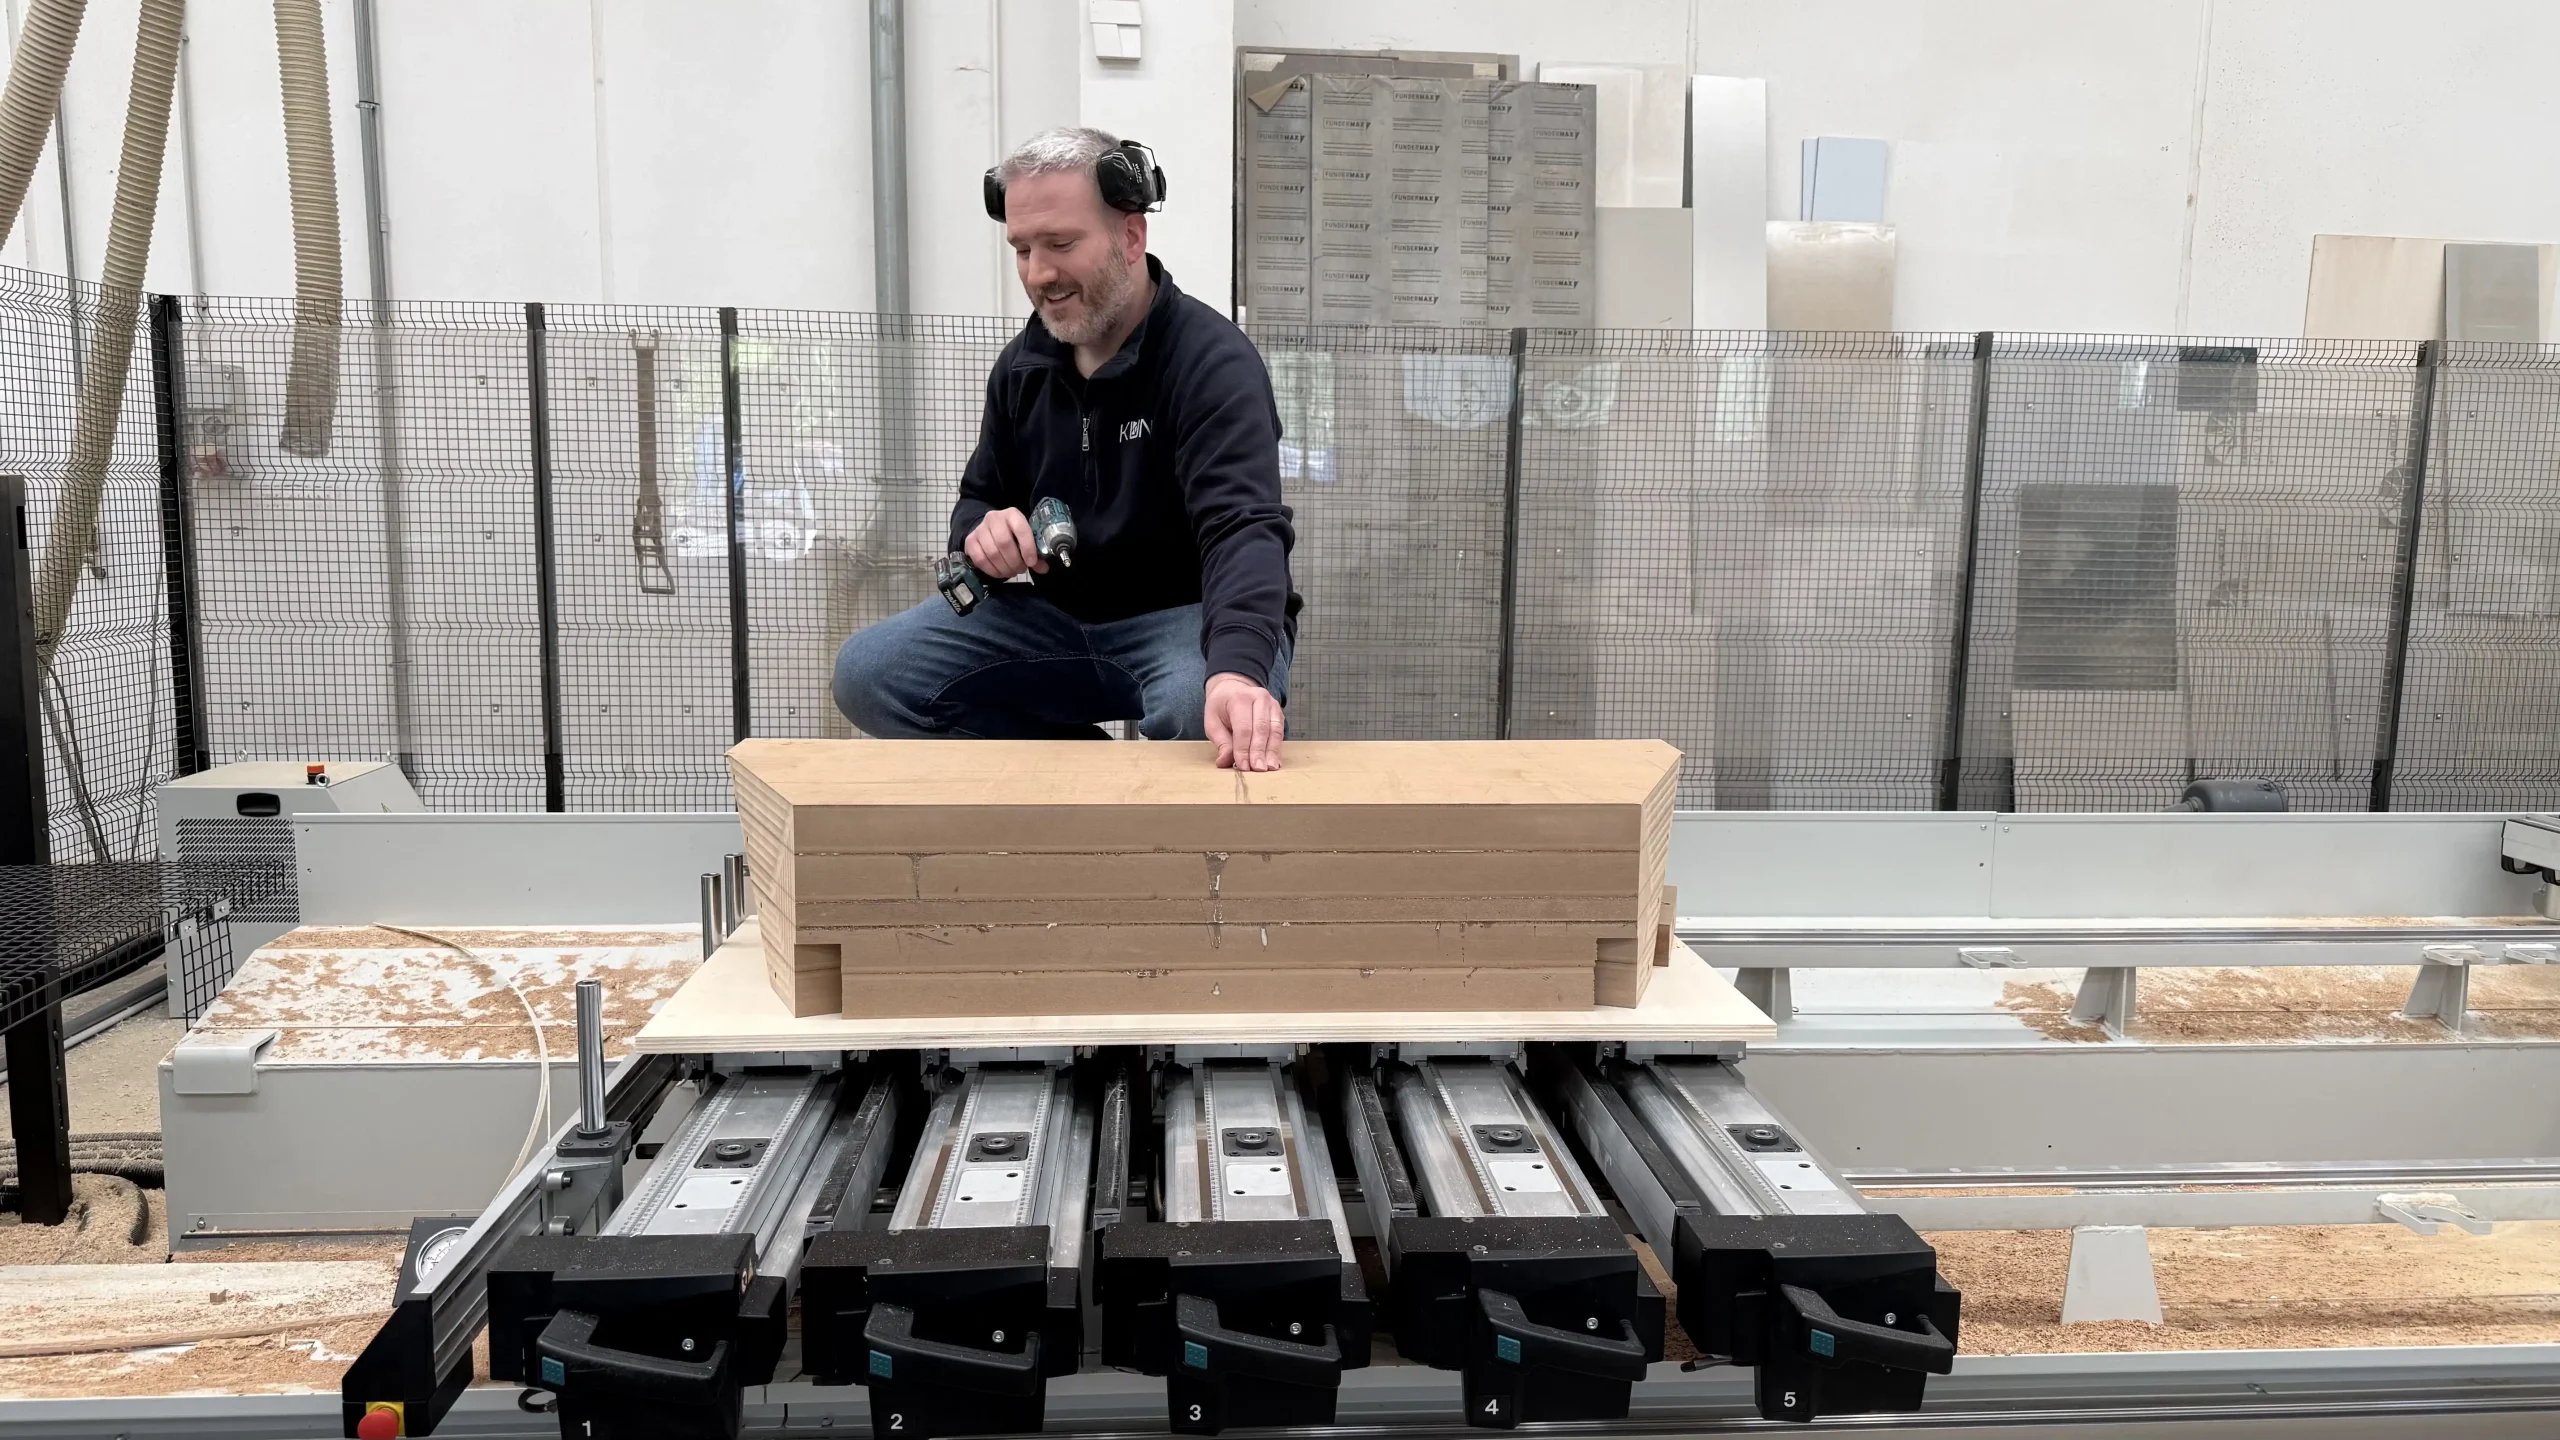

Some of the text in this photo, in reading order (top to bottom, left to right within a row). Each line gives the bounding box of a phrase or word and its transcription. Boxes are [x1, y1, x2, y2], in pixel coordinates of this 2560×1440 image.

[1325, 120, 1365, 128] FUNDERMAX
[1536, 129, 1573, 137] FUNDERMAX
[1395, 143, 1433, 151] FUNDERMAX
[1325, 170, 1364, 179] FUNDERMAX
[1259, 184, 1299, 192] FUNDERMAX
[1394, 244, 1432, 252] FUNDERMAX
[1783, 1391, 1796, 1408] 5
[1484, 1398, 1500, 1415] 4
[1189, 1404, 1202, 1421] 3
[890, 1413, 903, 1430] 2
[582, 1420, 591, 1437] 1
